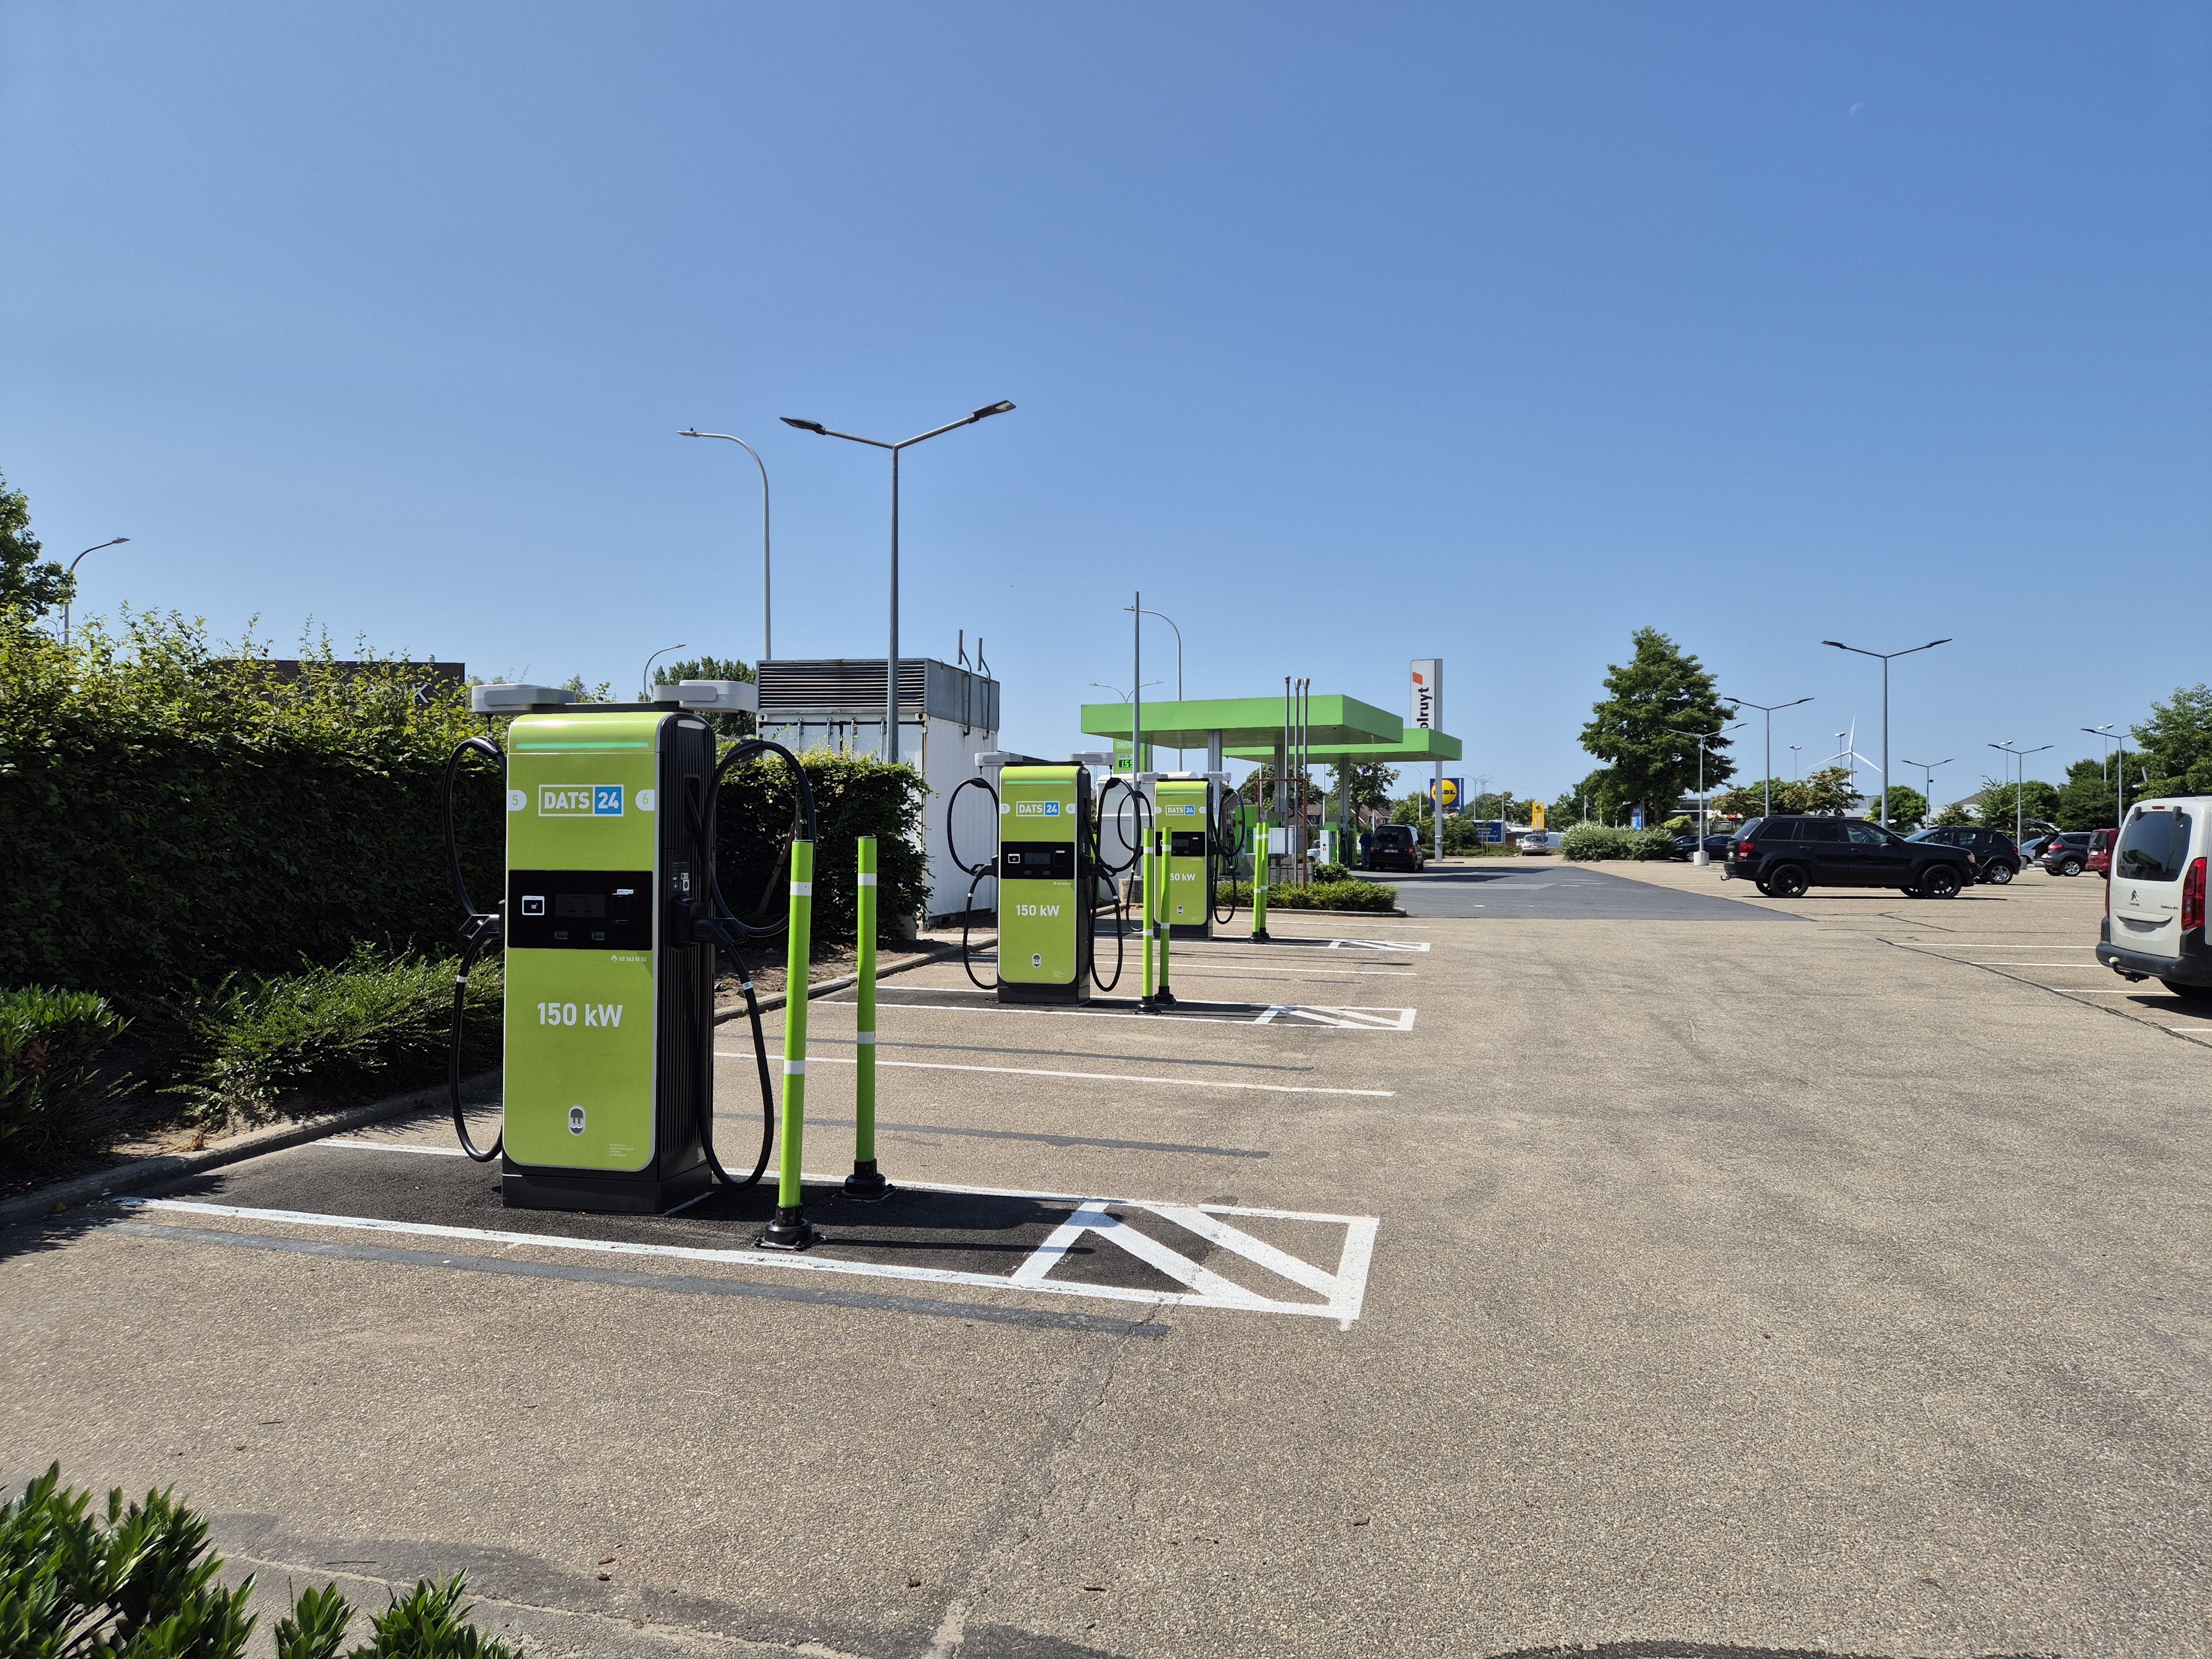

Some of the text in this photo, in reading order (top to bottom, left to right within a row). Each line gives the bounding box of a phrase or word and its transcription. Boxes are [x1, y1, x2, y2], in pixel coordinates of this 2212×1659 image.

[1417, 687, 1433, 728] olruyt
[512, 795, 519, 806] 5
[544, 792, 619, 809] DATS 24
[641, 793, 649, 805] 6
[1019, 804, 1057, 813] DATS 24
[1016, 905, 1060, 916] 150 kW
[538, 1003, 623, 1027] 150 kW
